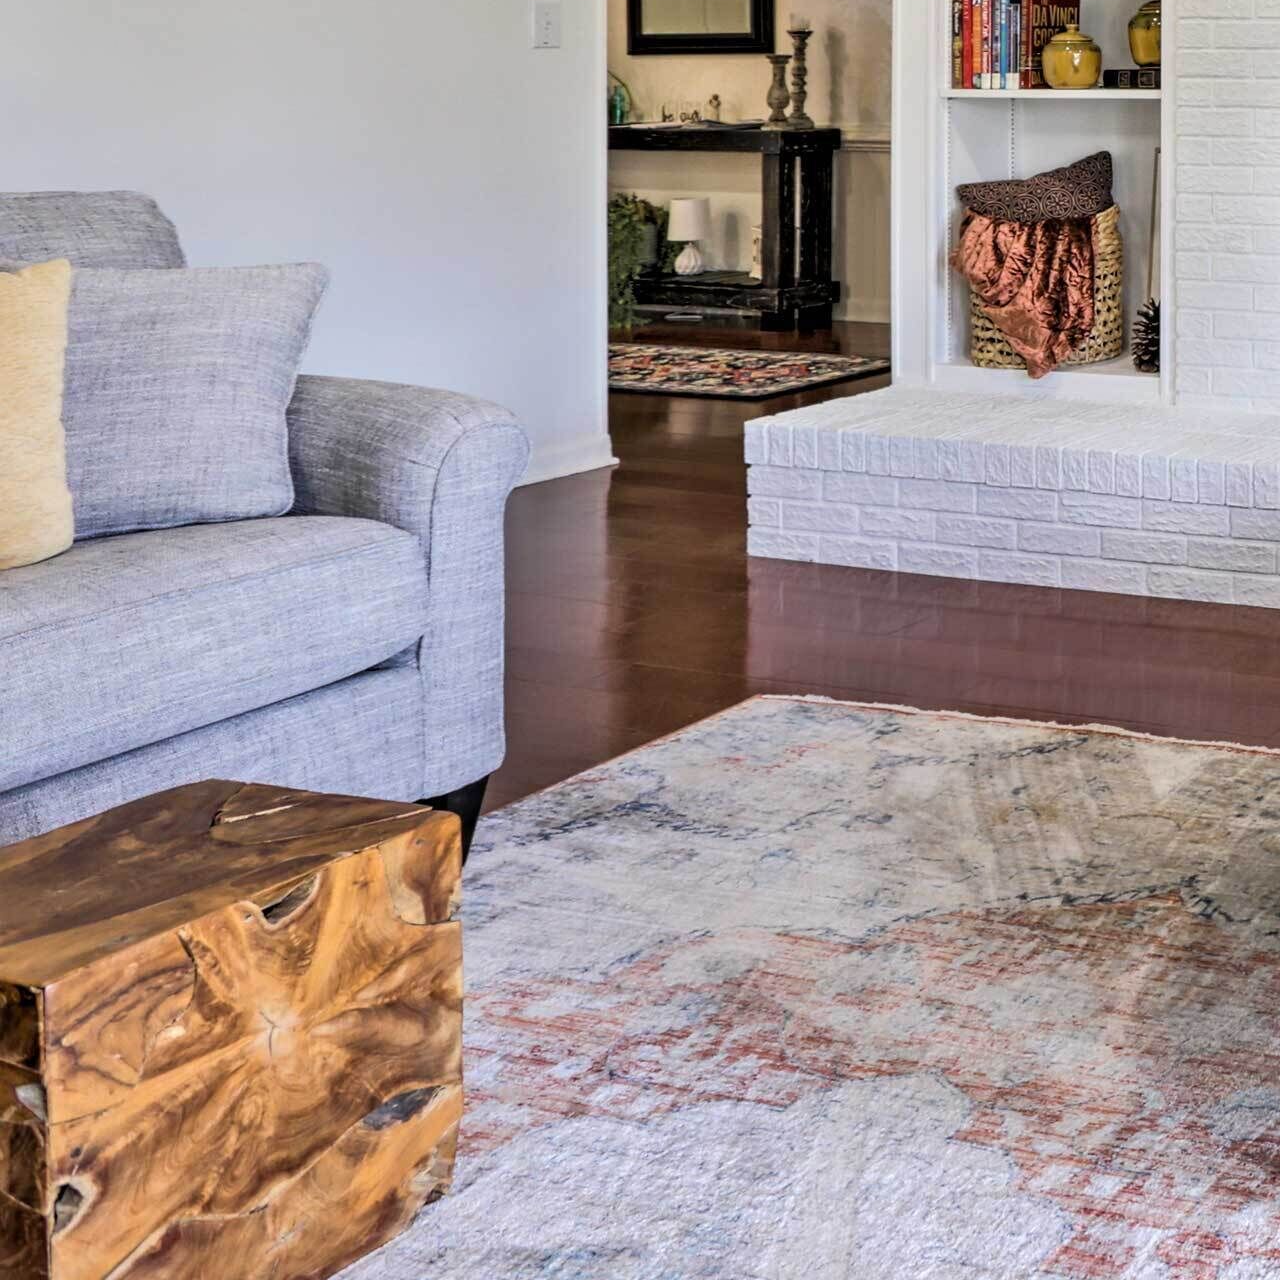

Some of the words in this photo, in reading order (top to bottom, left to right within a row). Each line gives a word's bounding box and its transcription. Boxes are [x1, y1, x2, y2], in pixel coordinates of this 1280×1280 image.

[1032, 4, 1048, 27] DA
[1049, 4, 1078, 27] VINCI
[1033, 28, 1060, 47] CO
